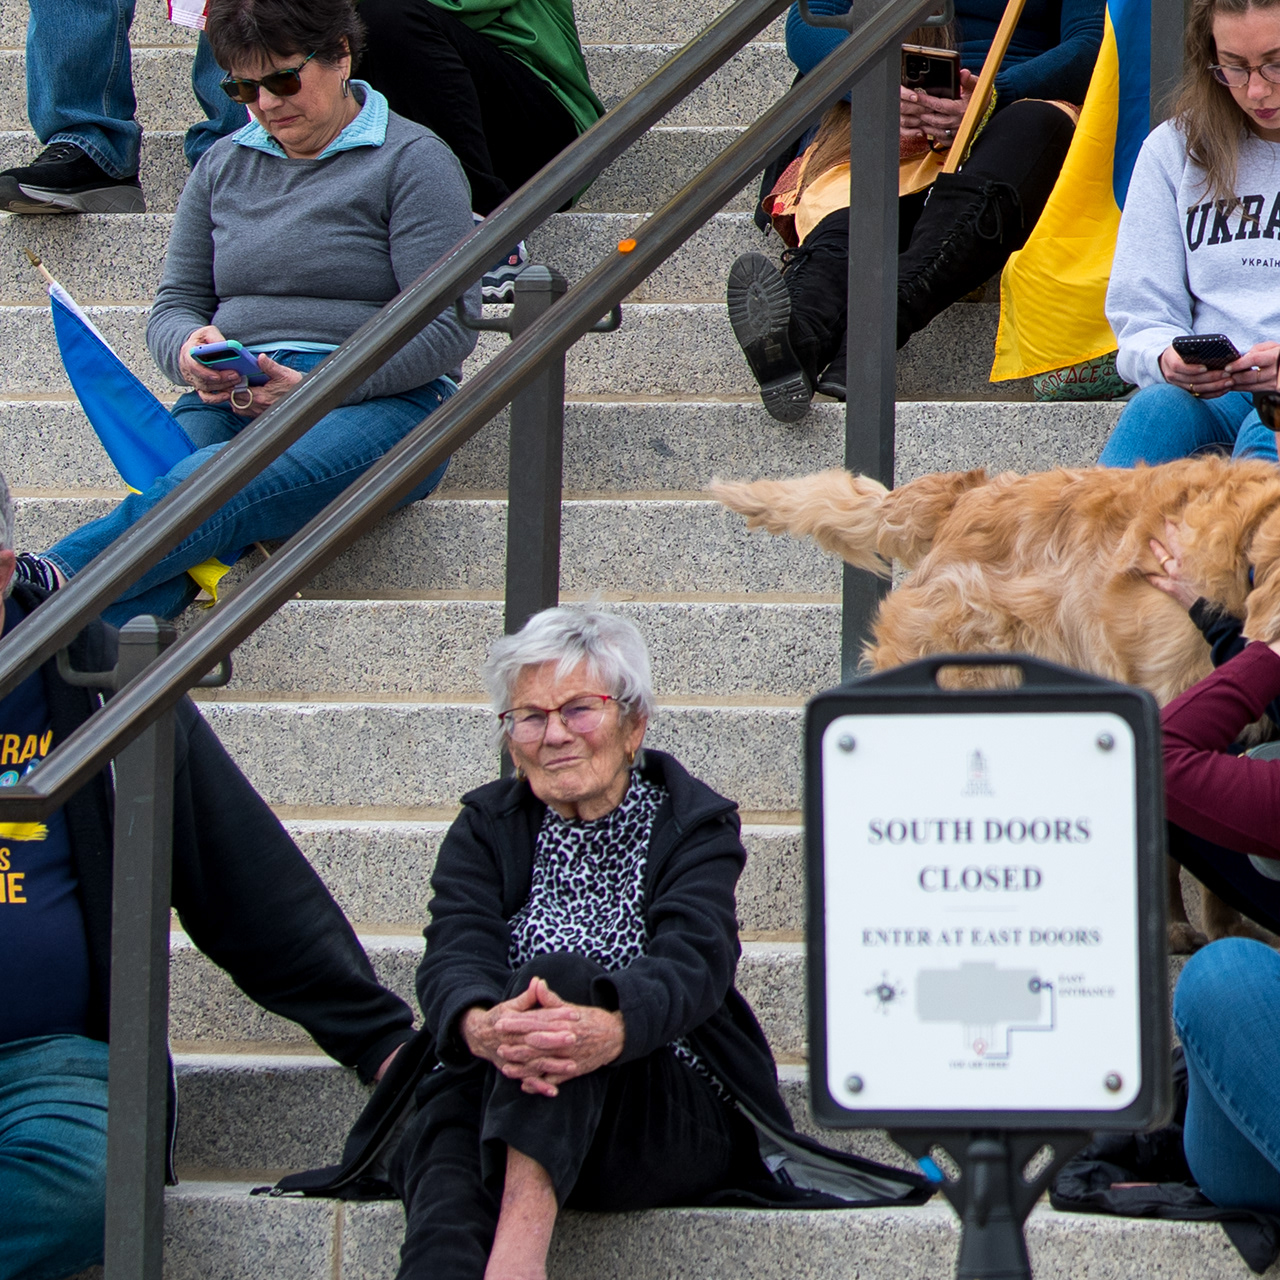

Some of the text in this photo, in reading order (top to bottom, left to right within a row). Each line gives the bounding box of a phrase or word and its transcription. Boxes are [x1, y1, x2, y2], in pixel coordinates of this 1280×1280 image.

[868, 817, 1092, 845] SOUTH DOORS
[918, 865, 1043, 892] CLOSED
[862, 927, 1101, 947] ENTER AT EAST DOORS
